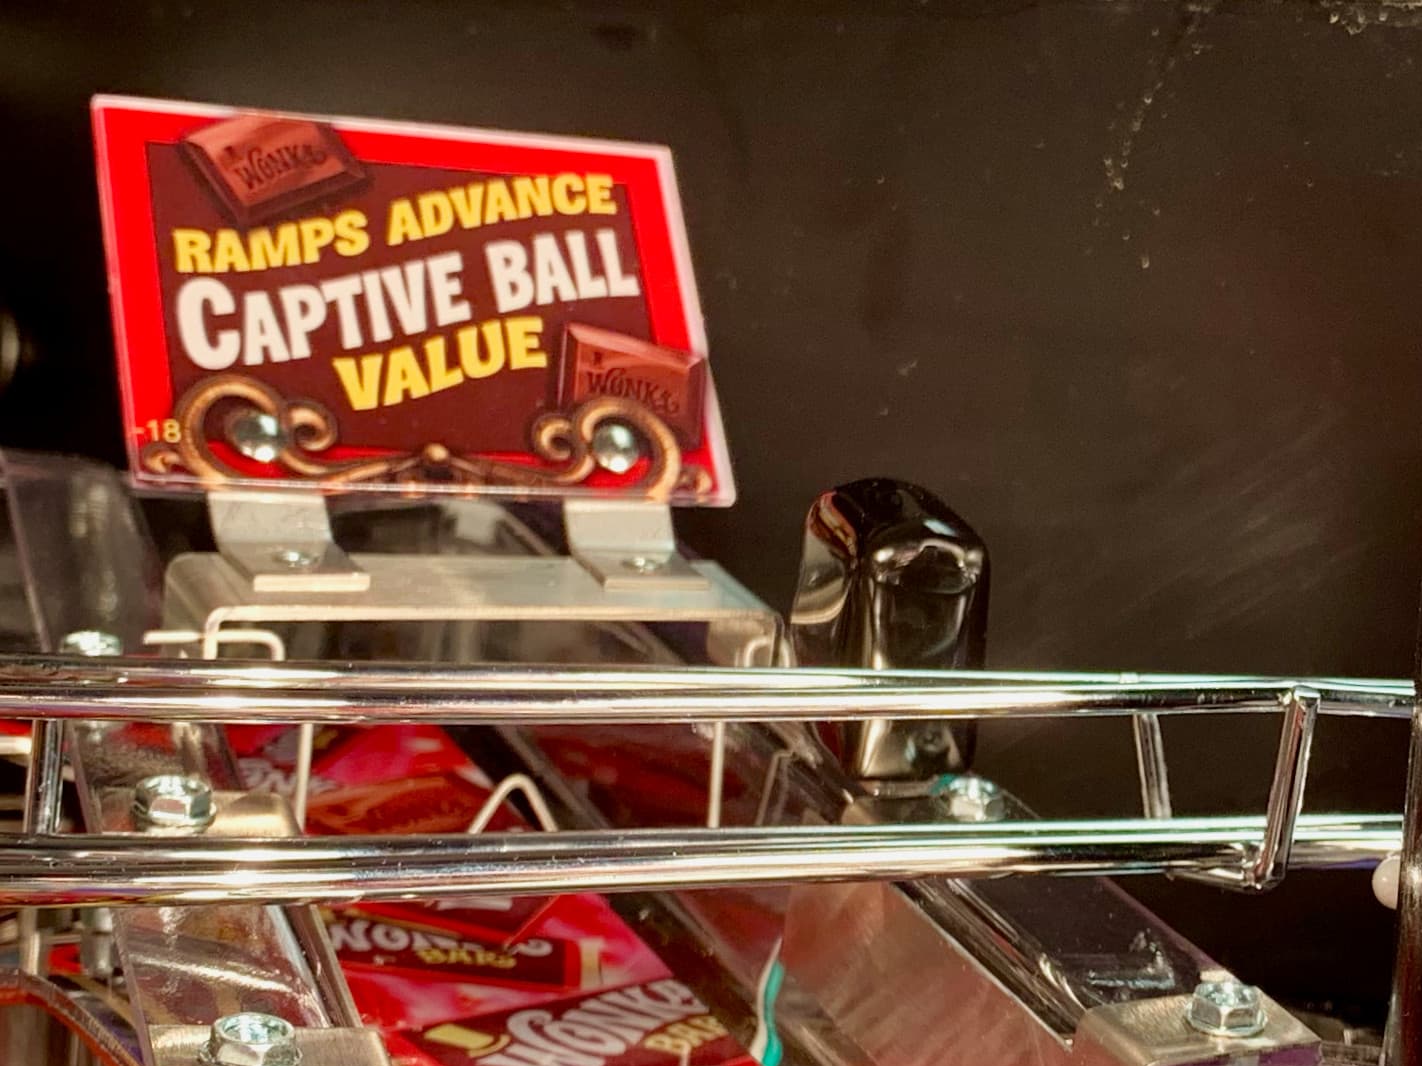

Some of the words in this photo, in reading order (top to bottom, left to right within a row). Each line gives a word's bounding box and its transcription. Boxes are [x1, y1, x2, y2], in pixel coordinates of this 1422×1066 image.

[172, 212, 370, 275] RAMPS
[387, 173, 619, 247] ADVANCE
[176, 251, 472, 371] CAPTIVE
[485, 229, 641, 315] BALL
[332, 316, 549, 412] VALUE
